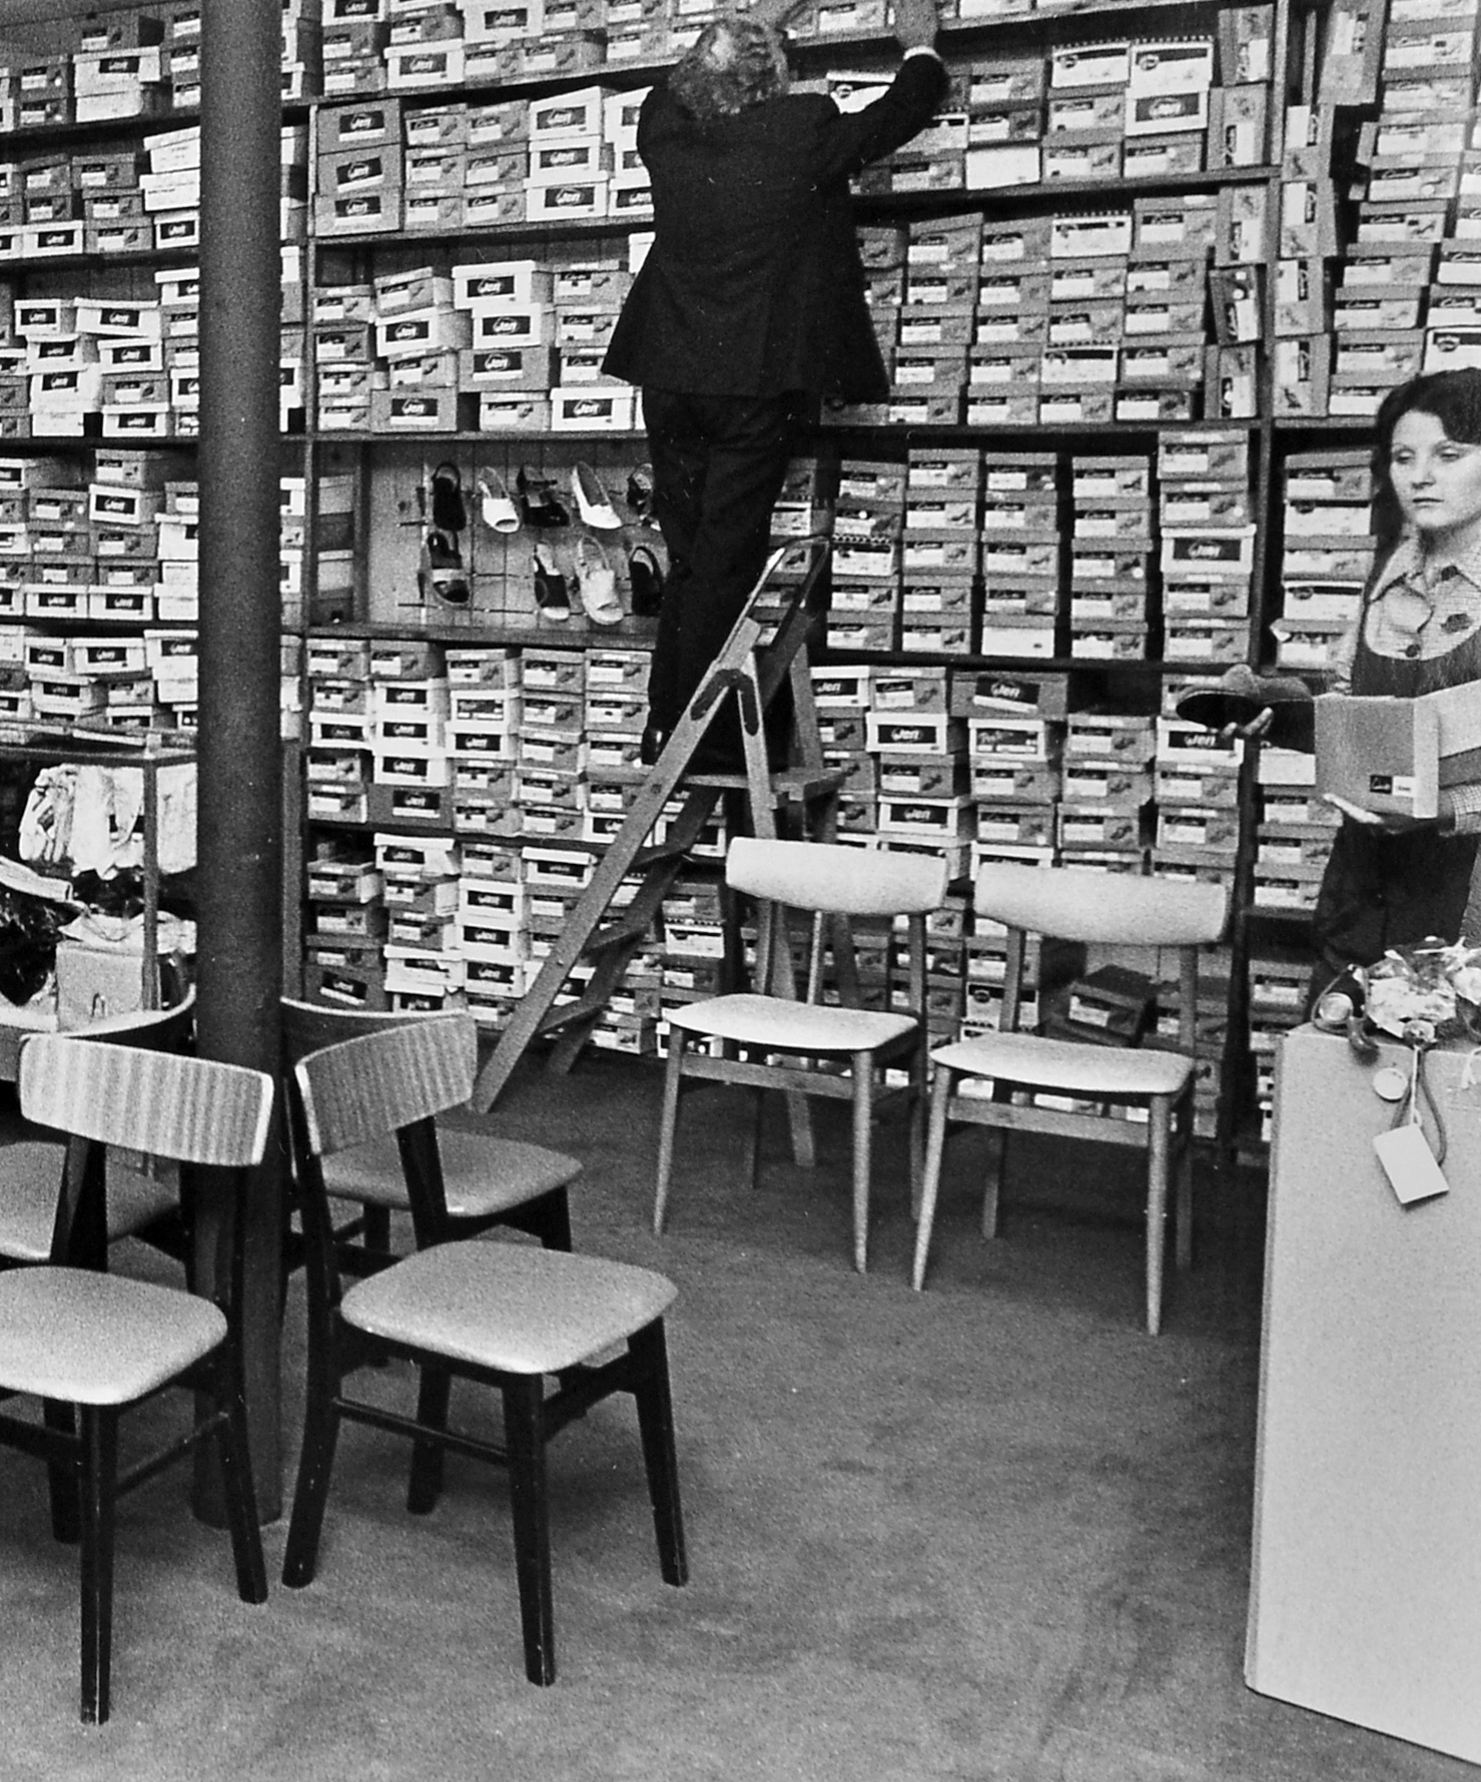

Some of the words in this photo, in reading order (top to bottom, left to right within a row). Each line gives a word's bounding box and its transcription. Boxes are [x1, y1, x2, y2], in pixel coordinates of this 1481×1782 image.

[816, 683, 841, 692] Jen
[991, 684, 1020, 698] Jen
[891, 729, 920, 741] Jen
[1185, 735, 1216, 746] Jen
